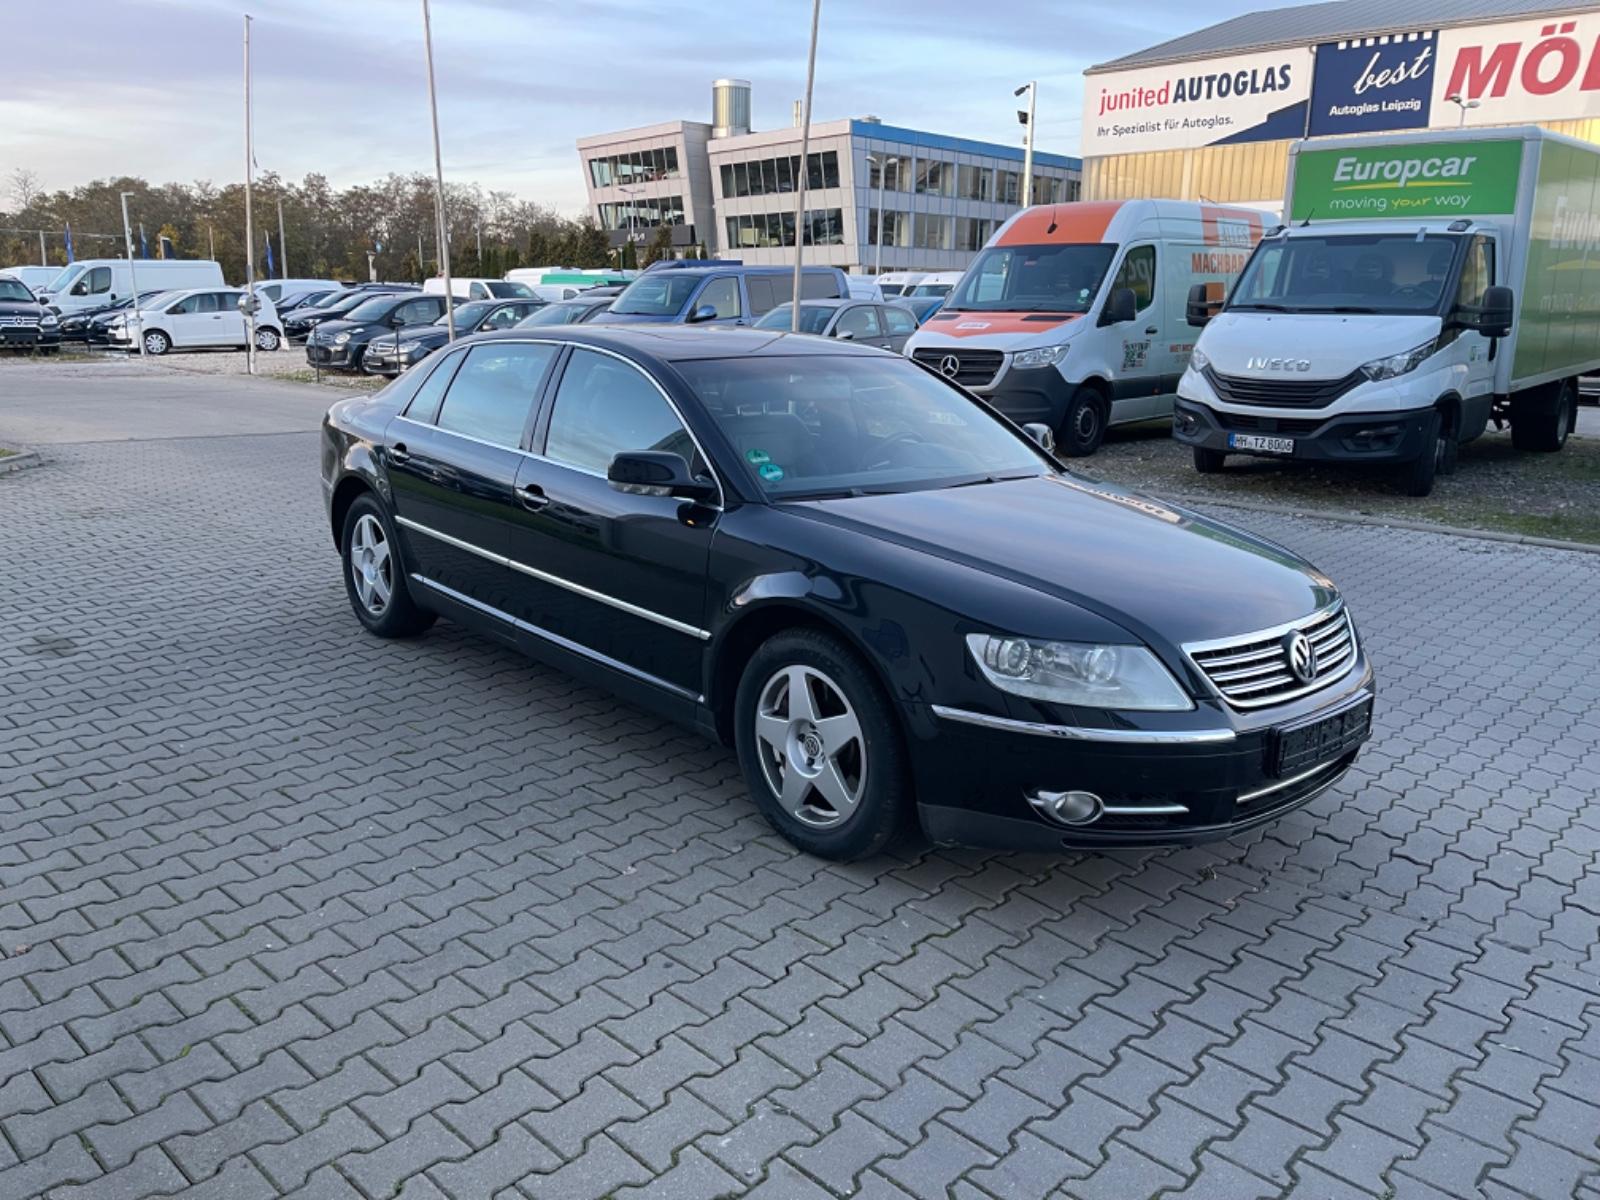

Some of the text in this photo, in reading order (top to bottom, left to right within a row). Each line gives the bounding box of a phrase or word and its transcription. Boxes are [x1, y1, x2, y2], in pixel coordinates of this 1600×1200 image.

[1353, 45, 1432, 95] best
[1098, 64, 1292, 117] junited AUTOGLAS
[1328, 98, 1422, 116] Autoglas Leipzig
[1096, 114, 1234, 137] Ihr Spezialist für Autoglas.
[1333, 155, 1478, 188] Europcar
[1329, 193, 1473, 212] moving your way
[1247, 357, 1312, 373] IVECO
